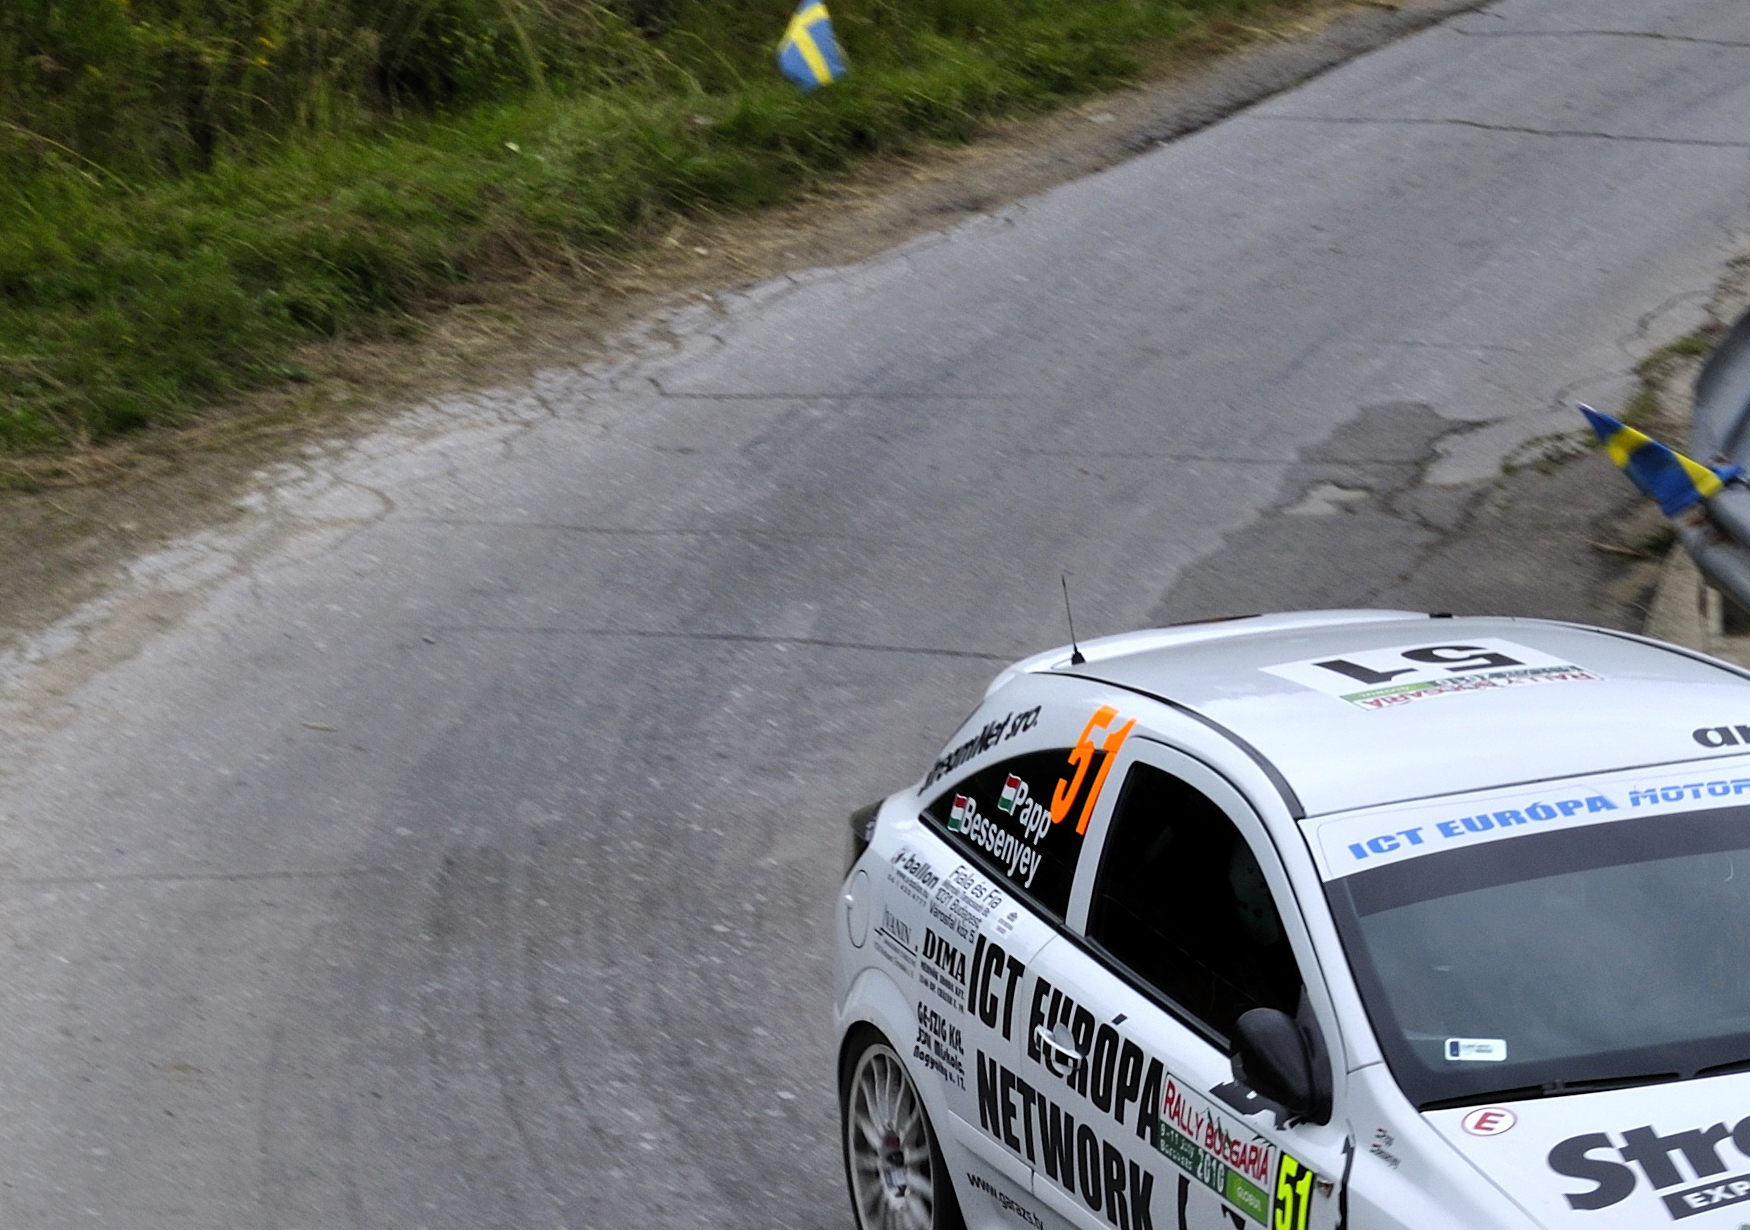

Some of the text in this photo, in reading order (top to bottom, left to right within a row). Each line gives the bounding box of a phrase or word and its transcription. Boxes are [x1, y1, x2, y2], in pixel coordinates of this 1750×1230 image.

[1312, 646, 1526, 684] 51
[1010, 781, 1051, 845] Papp
[1051, 704, 1137, 835] 51
[960, 797, 1042, 889] Bessenyey
[1348, 827, 1424, 861] ICT
[1435, 794, 1618, 839] EURÓPA
[922, 927, 966, 987] DIMA
[968, 932, 1026, 1042] ICT
[1027, 976, 1164, 1150] EURÓPA
[1163, 1080, 1270, 1186] RALLY BULGARIA
